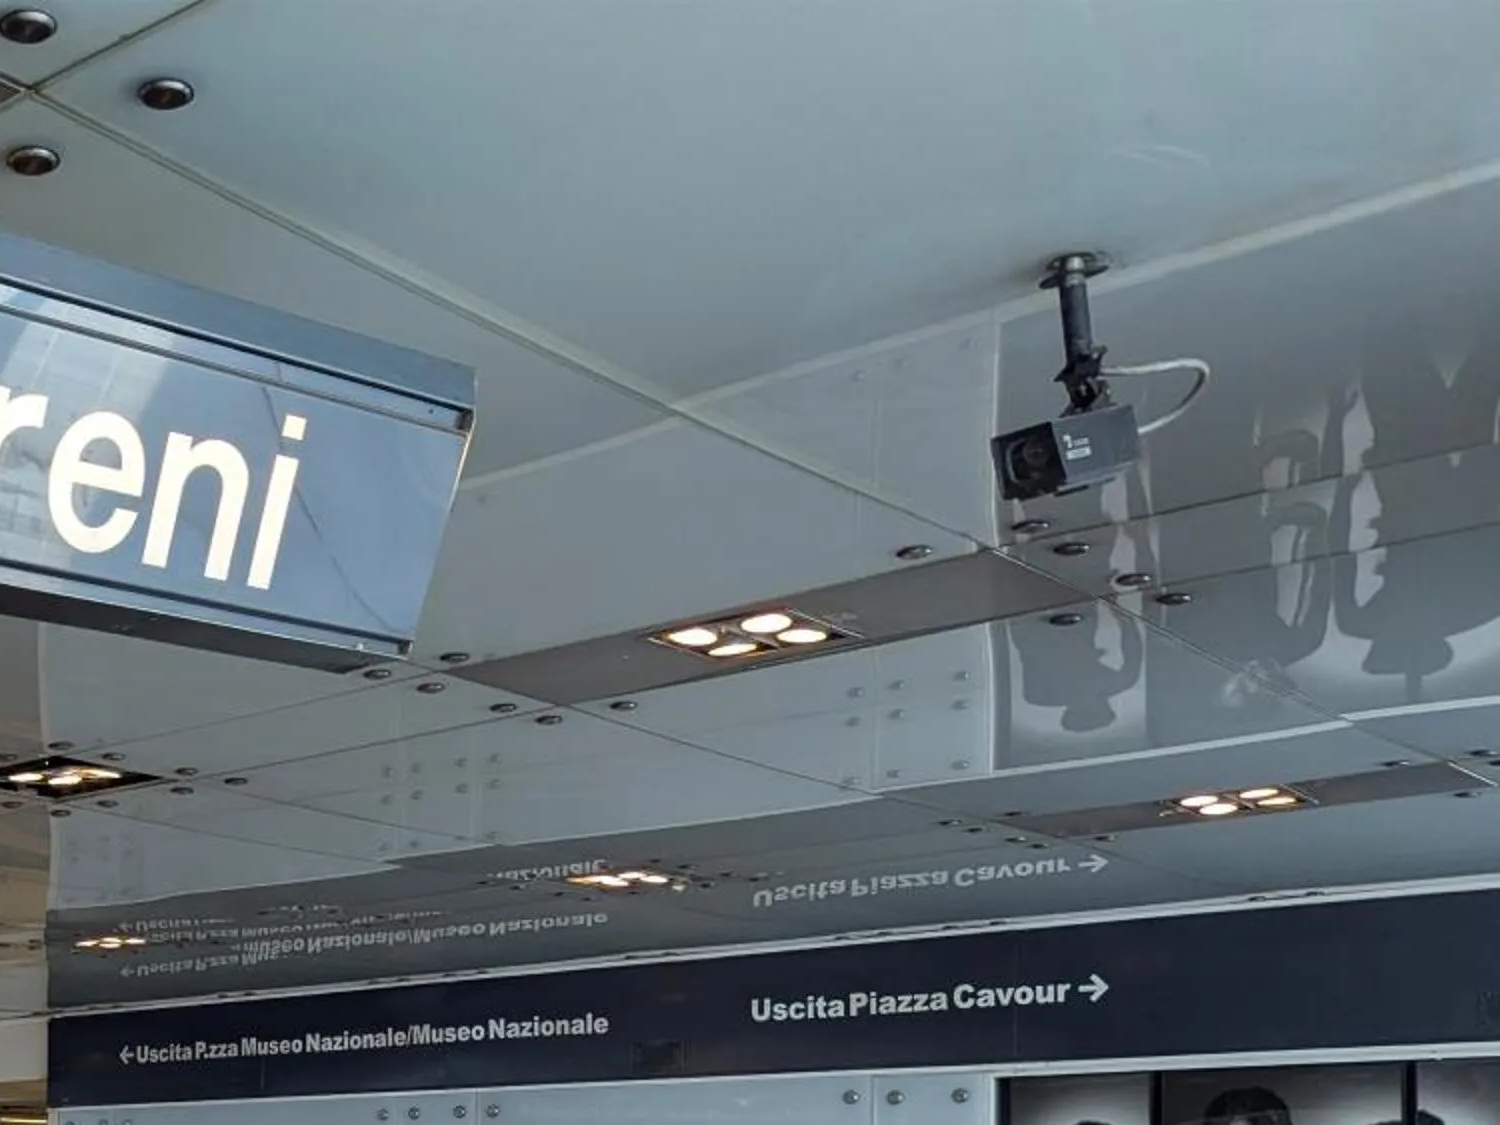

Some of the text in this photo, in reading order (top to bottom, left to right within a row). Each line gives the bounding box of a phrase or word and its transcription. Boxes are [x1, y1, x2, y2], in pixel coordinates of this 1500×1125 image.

[751, 980, 1071, 1022] Uscita Piazza Cavour
[136, 1012, 610, 1064] Uscita P.zza Museo Nazionale/Museo Nazionale
